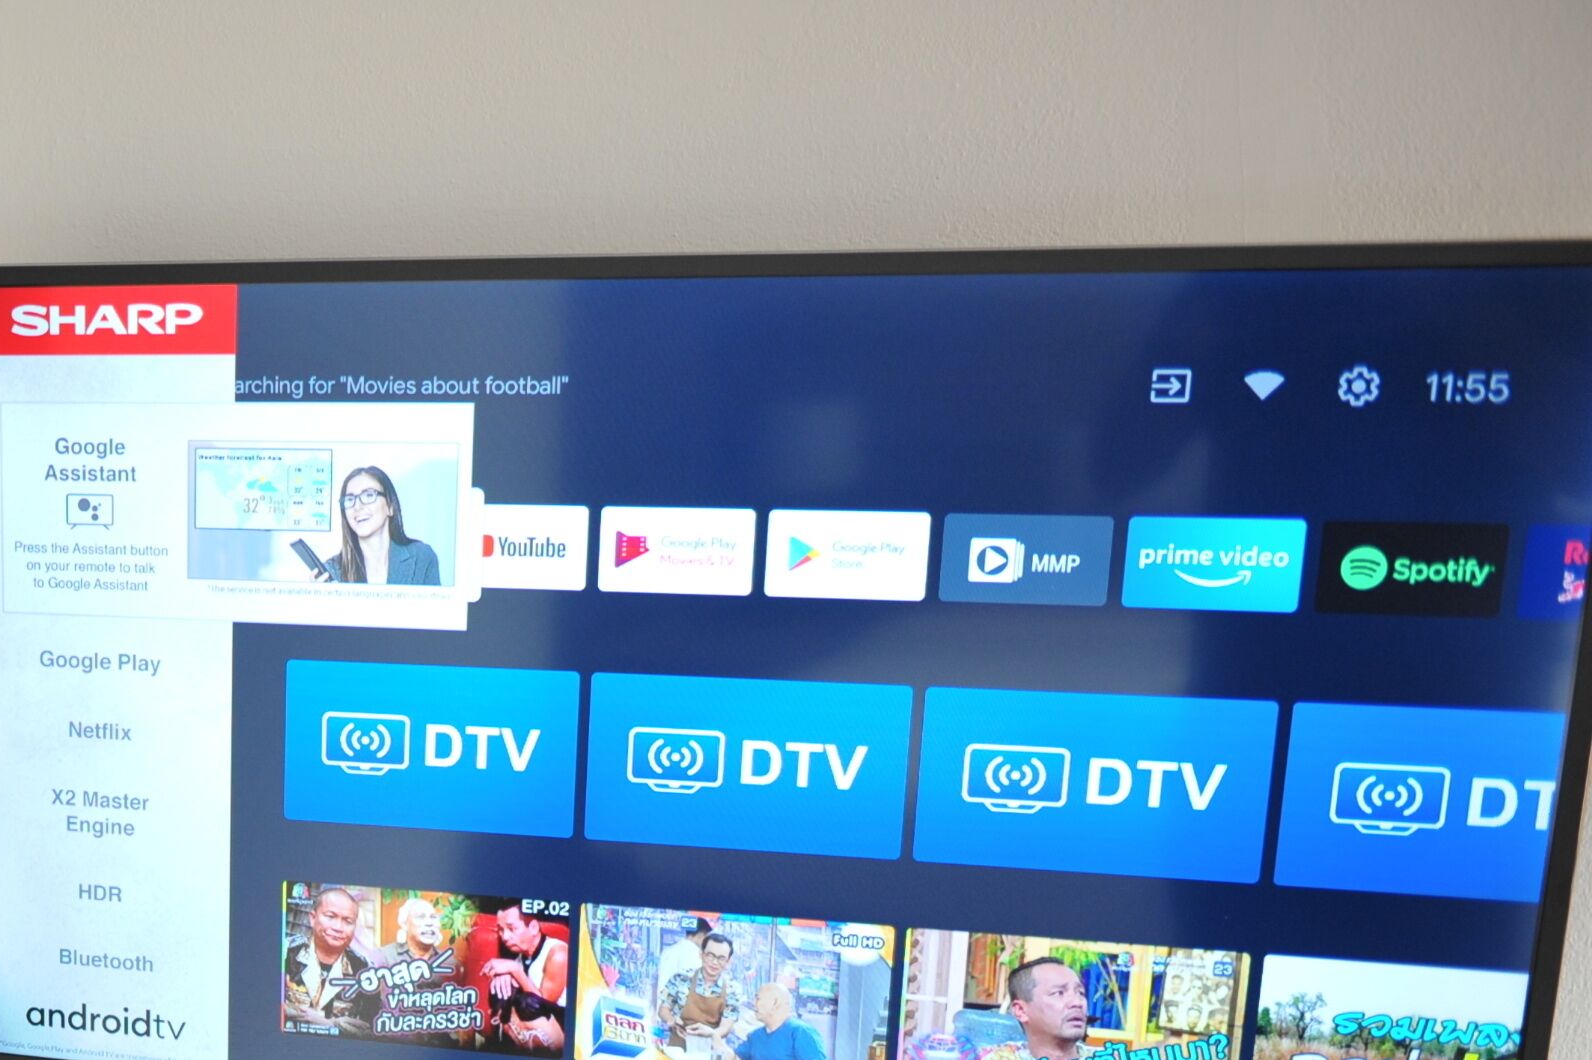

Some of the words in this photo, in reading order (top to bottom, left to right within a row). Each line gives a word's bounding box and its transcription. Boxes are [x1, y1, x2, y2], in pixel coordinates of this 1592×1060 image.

[11, 303, 203, 336] SHARP
[308, 376, 335, 394] for
[340, 376, 416, 394] "Movies
[421, 377, 479, 395] about
[484, 376, 569, 395] football"
[1426, 371, 1510, 403] 11:55
[54, 438, 125, 459] Google
[45, 464, 136, 483] Assistant
[14, 541, 47, 555] Press
[51, 542, 69, 555] the
[72, 542, 127, 556] Assistant
[130, 543, 169, 557] button
[497, 536, 566, 560] YouTube
[661, 536, 706, 550] Google
[709, 537, 736, 551] Play
[832, 541, 878, 555] Google
[880, 543, 905, 556] Play
[26, 561, 41, 572] on
[44, 560, 70, 573] your
[74, 561, 116, 573] remote
[119, 561, 131, 574] to
[134, 562, 155, 574] talk
[1030, 553, 1081, 573] MMP
[1139, 543, 1212, 569] prime
[1219, 543, 1290, 568] video
[1392, 556, 1491, 587] Spotify
[33, 576, 44, 588] to
[48, 576, 91, 591] Google
[93, 578, 148, 592] Assistant
[39, 650, 112, 674] Google
[118, 653, 160, 676] Play
[68, 721, 132, 741] Netflix
[422, 723, 541, 773] DTV
[739, 738, 869, 791] DTV
[1085, 757, 1227, 812] DTV
[51, 788, 76, 806] X2
[82, 790, 150, 811] Master
[66, 815, 135, 838] Engine
[78, 883, 122, 902] HDR
[521, 898, 570, 917] EP.02
[832, 932, 858, 948] Full
[861, 935, 885, 949] HD
[59, 948, 154, 973] Bluetooth
[1214, 962, 1233, 976] 23
[360, 959, 431, 993] ฮาสุด
[388, 985, 477, 1012] ขำหลุดโลก
